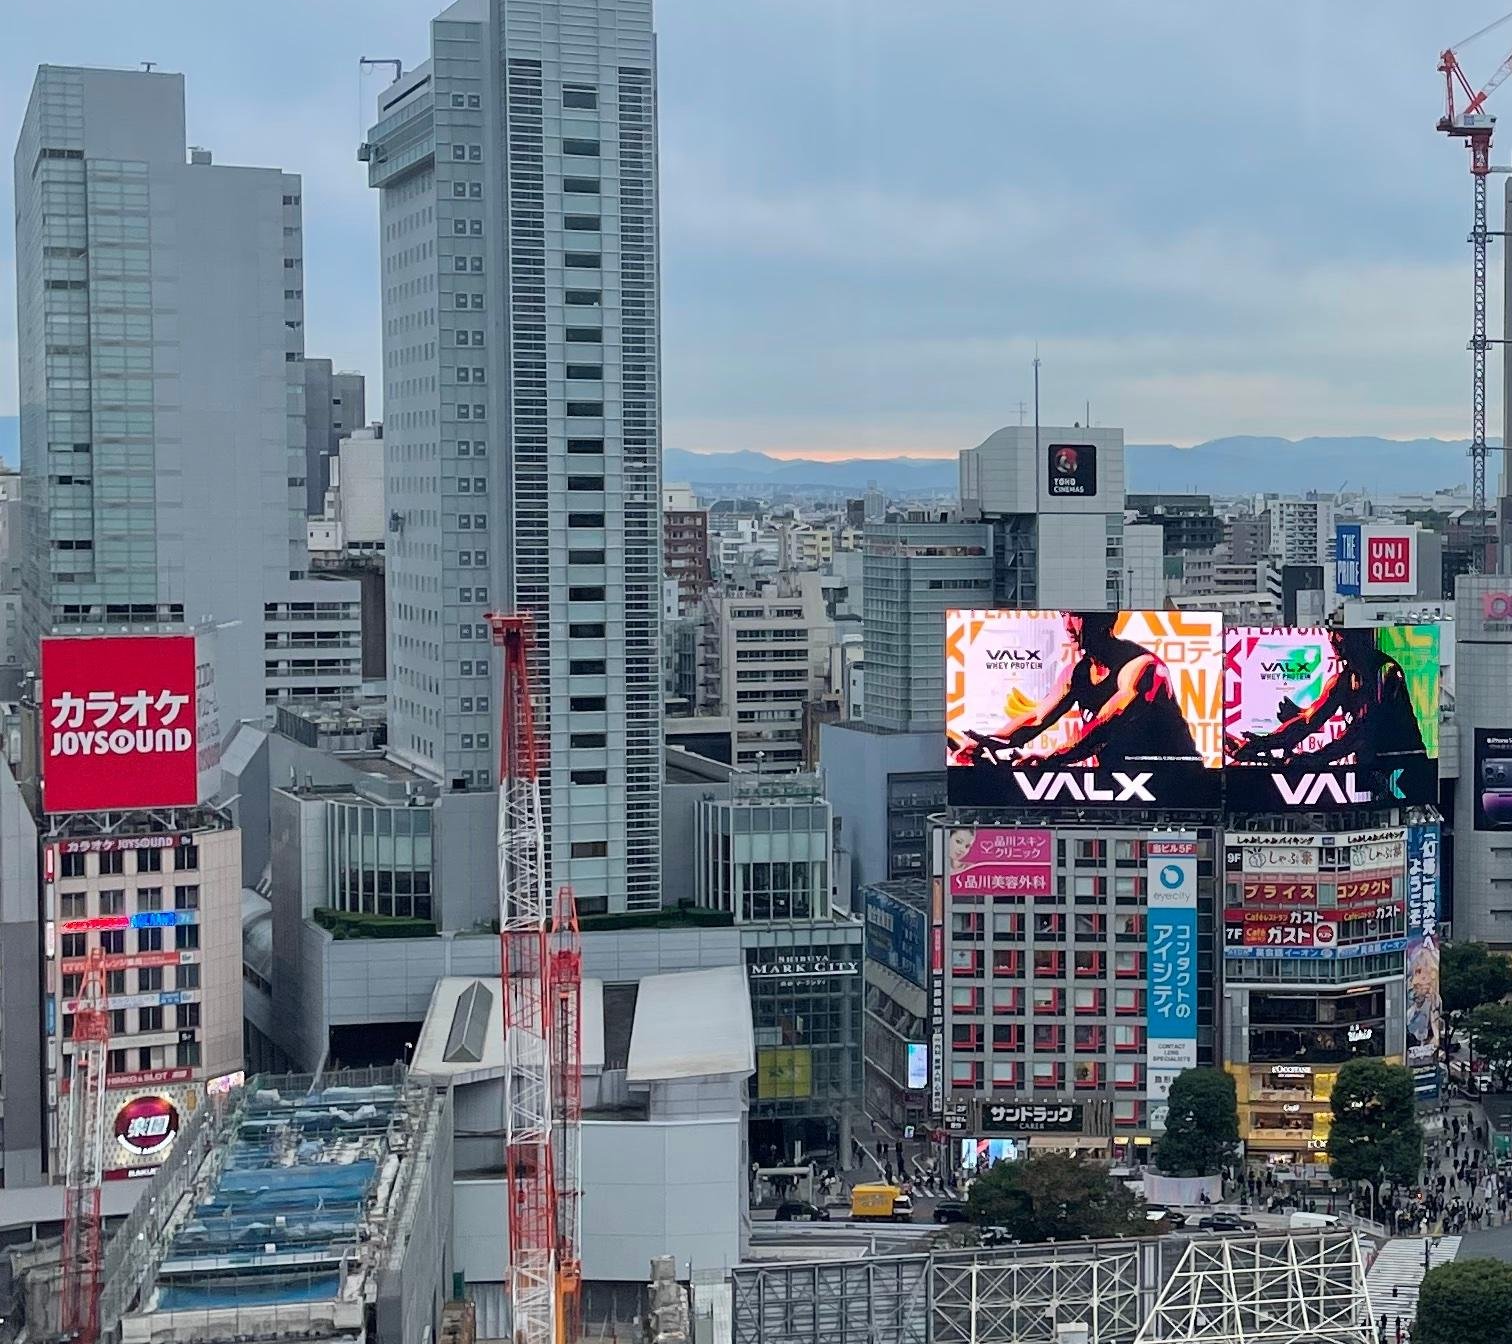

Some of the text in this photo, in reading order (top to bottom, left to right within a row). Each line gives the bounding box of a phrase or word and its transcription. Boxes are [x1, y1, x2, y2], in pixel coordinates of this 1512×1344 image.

[1342, 534, 1355, 559] THE
[1372, 543, 1402, 559] UNI
[1372, 562, 1405, 580] QLO
[986, 649, 1041, 661] VALX
[986, 662, 1043, 670] WHEY PROTEIN
[1261, 662, 1311, 672] VALX
[50, 689, 190, 729] カラオケ
[50, 728, 192, 757] JOYSOUND
[1013, 772, 1156, 801] VALX
[68, 840, 115, 853] カラオケ
[994, 835, 1046, 848] 品川スキン
[995, 847, 1041, 859] クリニック
[1227, 852, 1242, 864] 9F
[1244, 885, 1315, 899] プライス
[1337, 880, 1390, 898] コンタクト
[1153, 891, 1191, 902] eyecity
[1290, 910, 1324, 924] ガスト
[1376, 905, 1401, 920] ガスト
[1226, 928, 1243, 940] 7F
[1267, 926, 1310, 944] ガスト
[778, 955, 829, 963] SHIBUYA
[752, 962, 859, 974] MARK CITY
[1152, 924, 1172, 1018] アイシティ
[1177, 924, 1191, 1018] コンタクトの
[990, 1106, 1075, 1122] サンドラッグ
